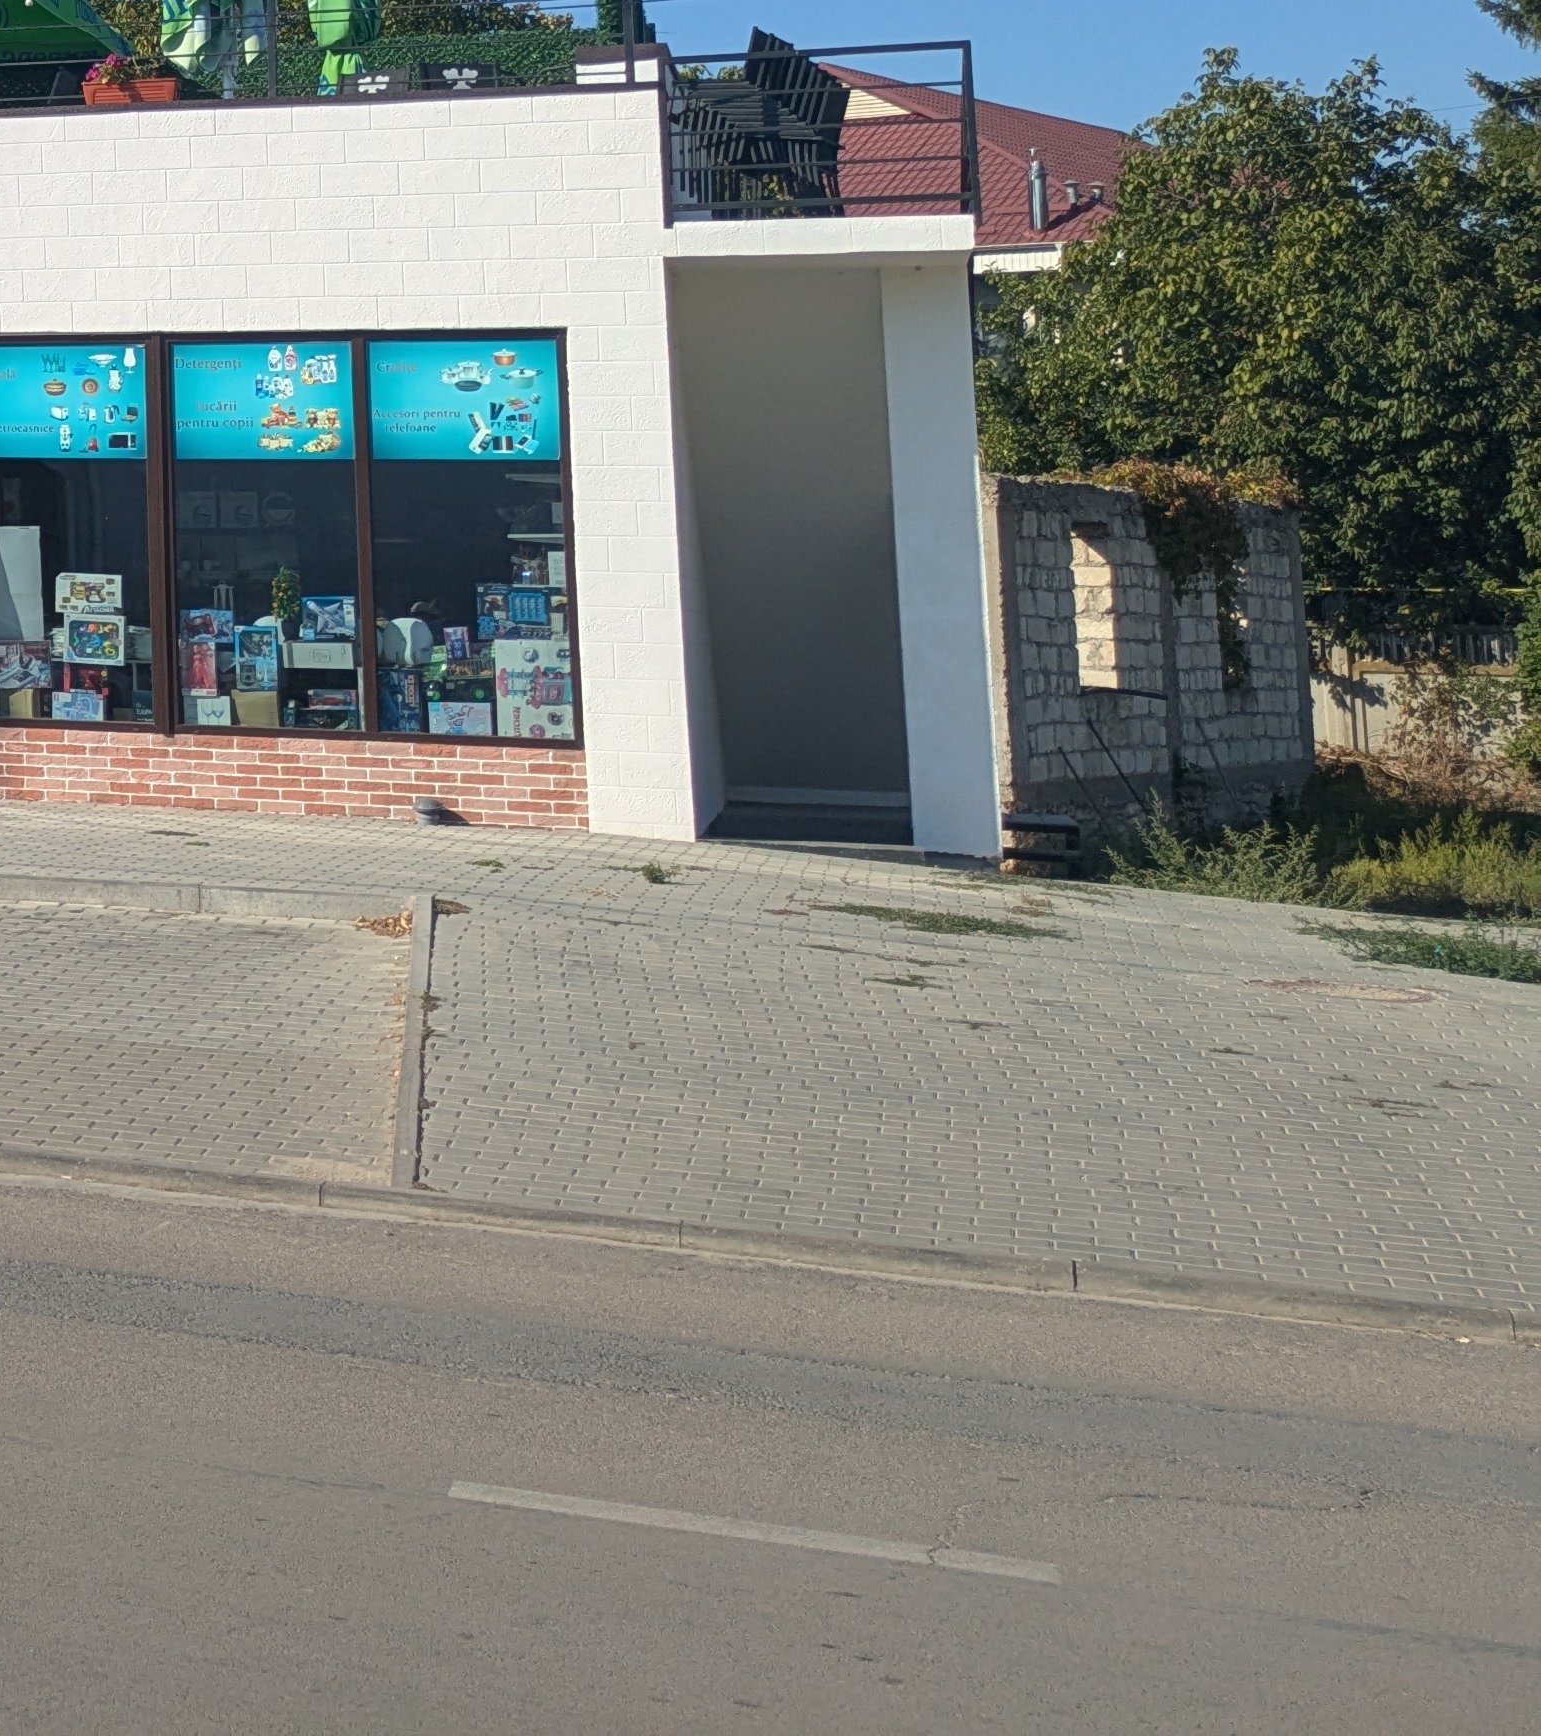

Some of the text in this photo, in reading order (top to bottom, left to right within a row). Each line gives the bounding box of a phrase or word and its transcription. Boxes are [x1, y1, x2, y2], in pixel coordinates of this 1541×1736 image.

[423, 409, 460, 420] pentru
[177, 416, 254, 430] pentru copii
[385, 423, 436, 433] telefoane
